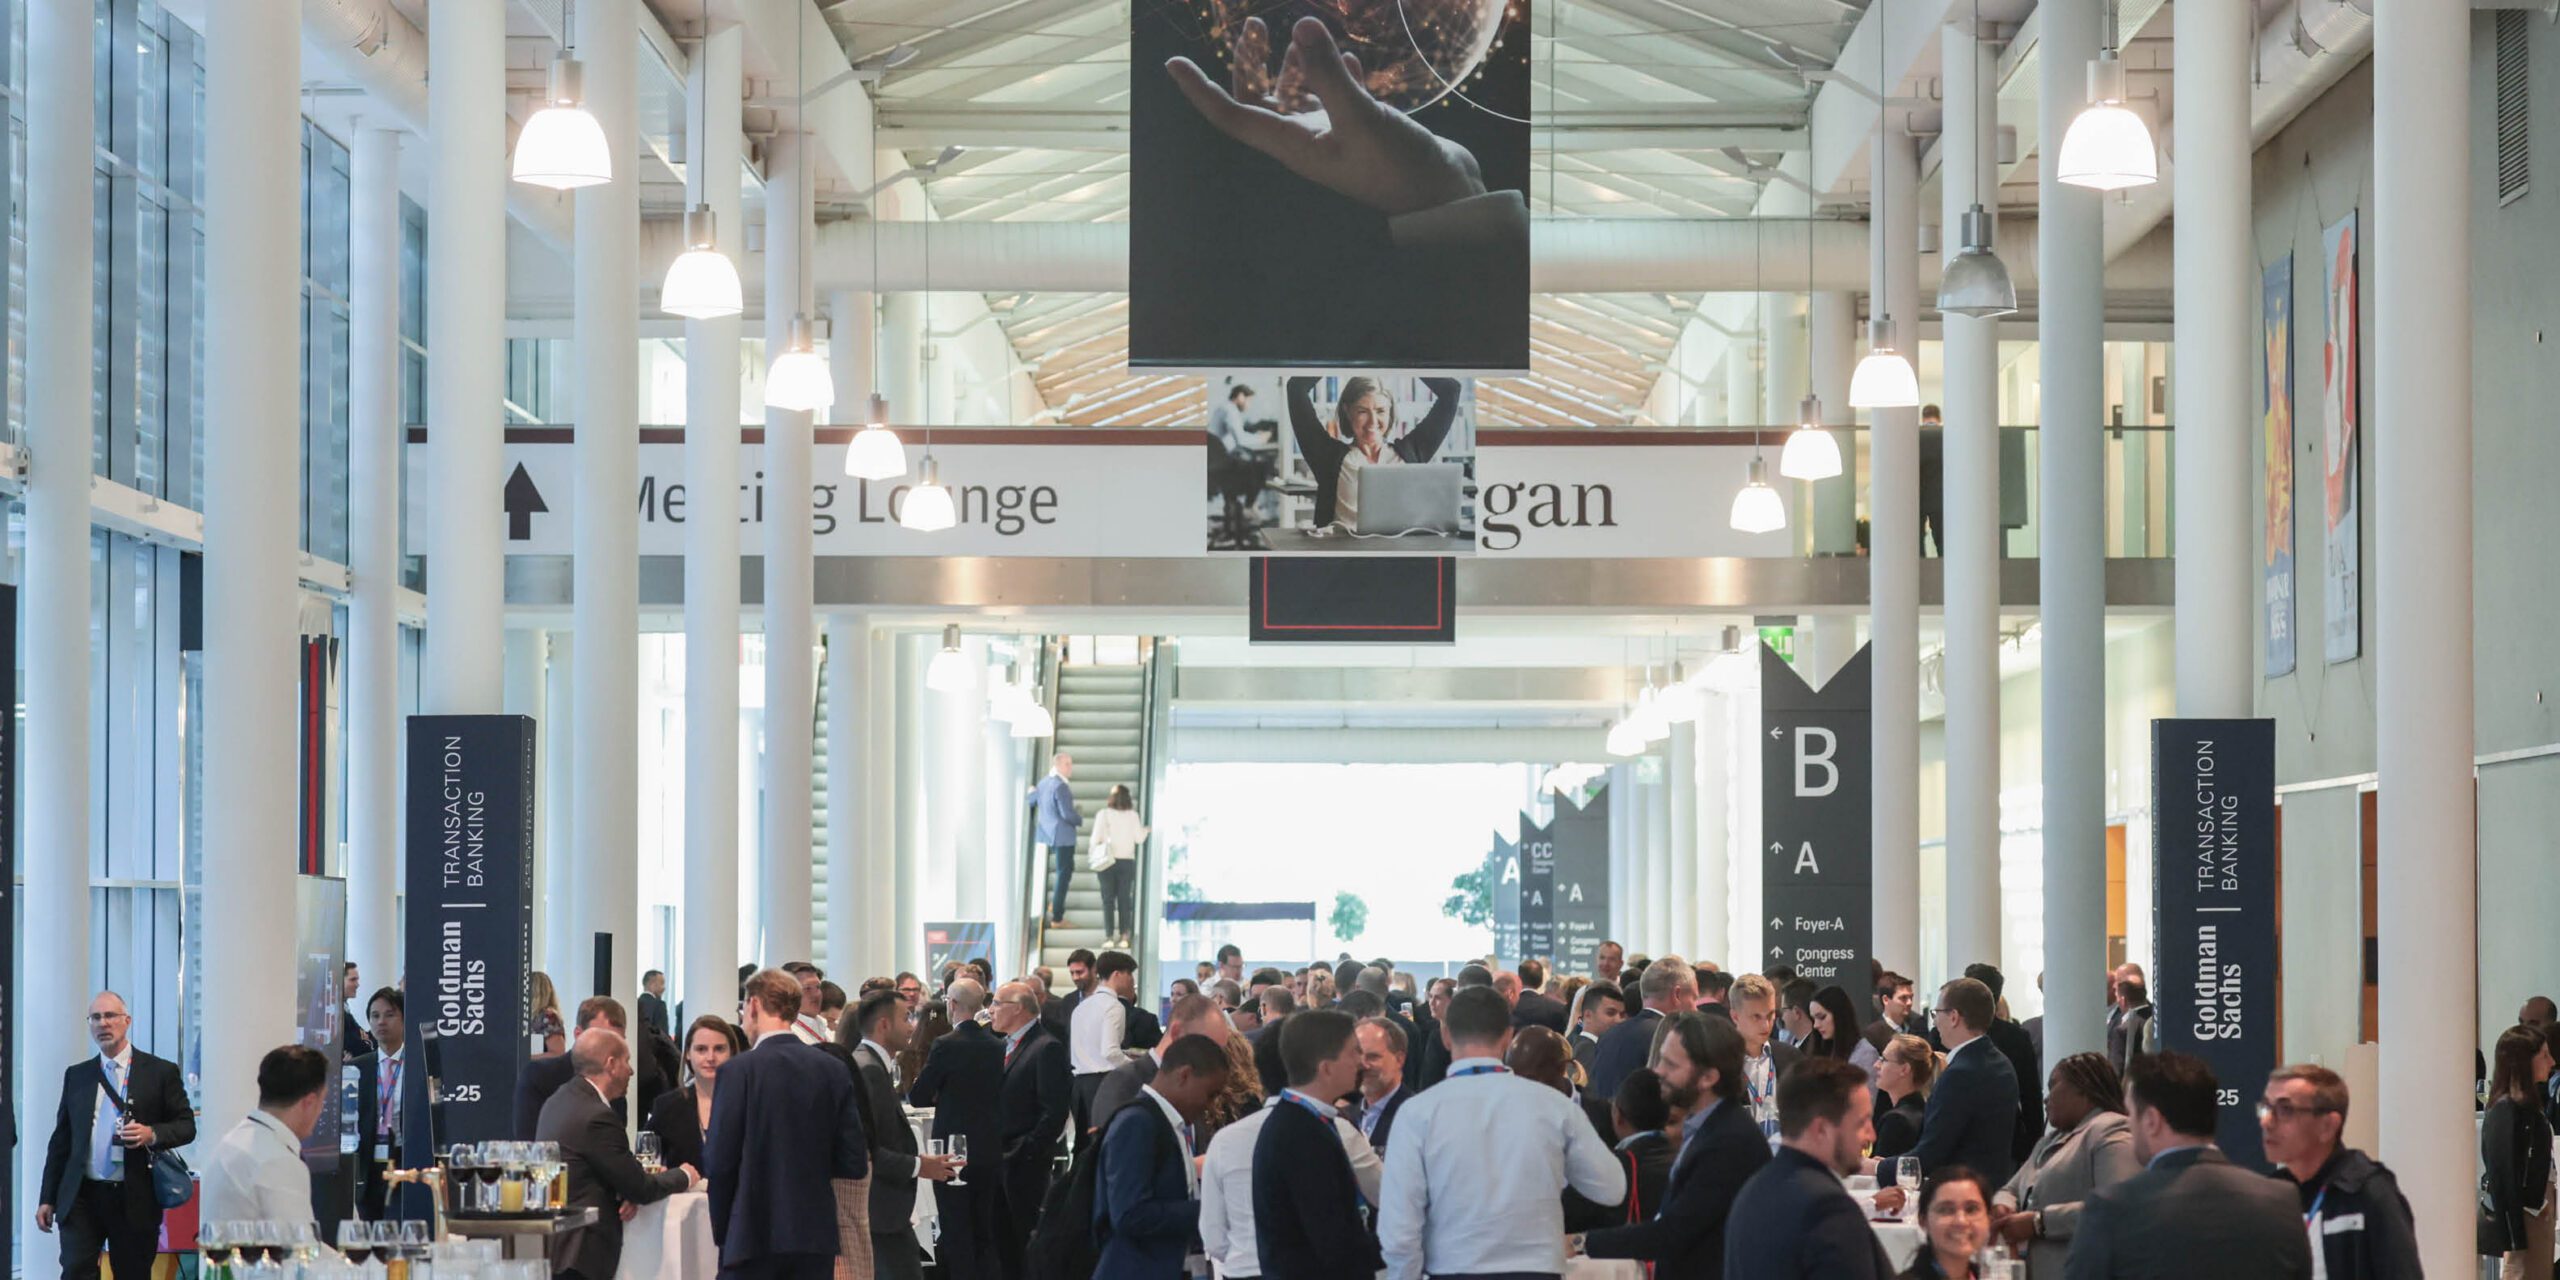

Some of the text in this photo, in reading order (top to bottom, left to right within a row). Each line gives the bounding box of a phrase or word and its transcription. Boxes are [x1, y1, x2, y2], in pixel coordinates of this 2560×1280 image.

[859, 477, 1058, 536] Longe
[1794, 726, 1839, 797] B
[444, 736, 461, 888] TRANSACTION
[467, 791, 484, 887] BANKING
[2197, 740, 2215, 892] TRANSACTION
[2221, 796, 2238, 891] BANKING
[1501, 856, 1520, 885] A
[1531, 842, 1553, 859] CC
[1794, 841, 1820, 874] A
[1531, 890, 1544, 906] A
[1569, 882, 1584, 902] A
[1795, 916, 1845, 934] Foyer-A
[1796, 948, 1855, 963] Congress
[437, 921, 461, 1037] Goldman
[461, 959, 485, 1035] Sachs
[1795, 963, 1837, 978] Center
[2193, 925, 2217, 1041] Goldman
[2218, 963, 2242, 1039] Sachs
